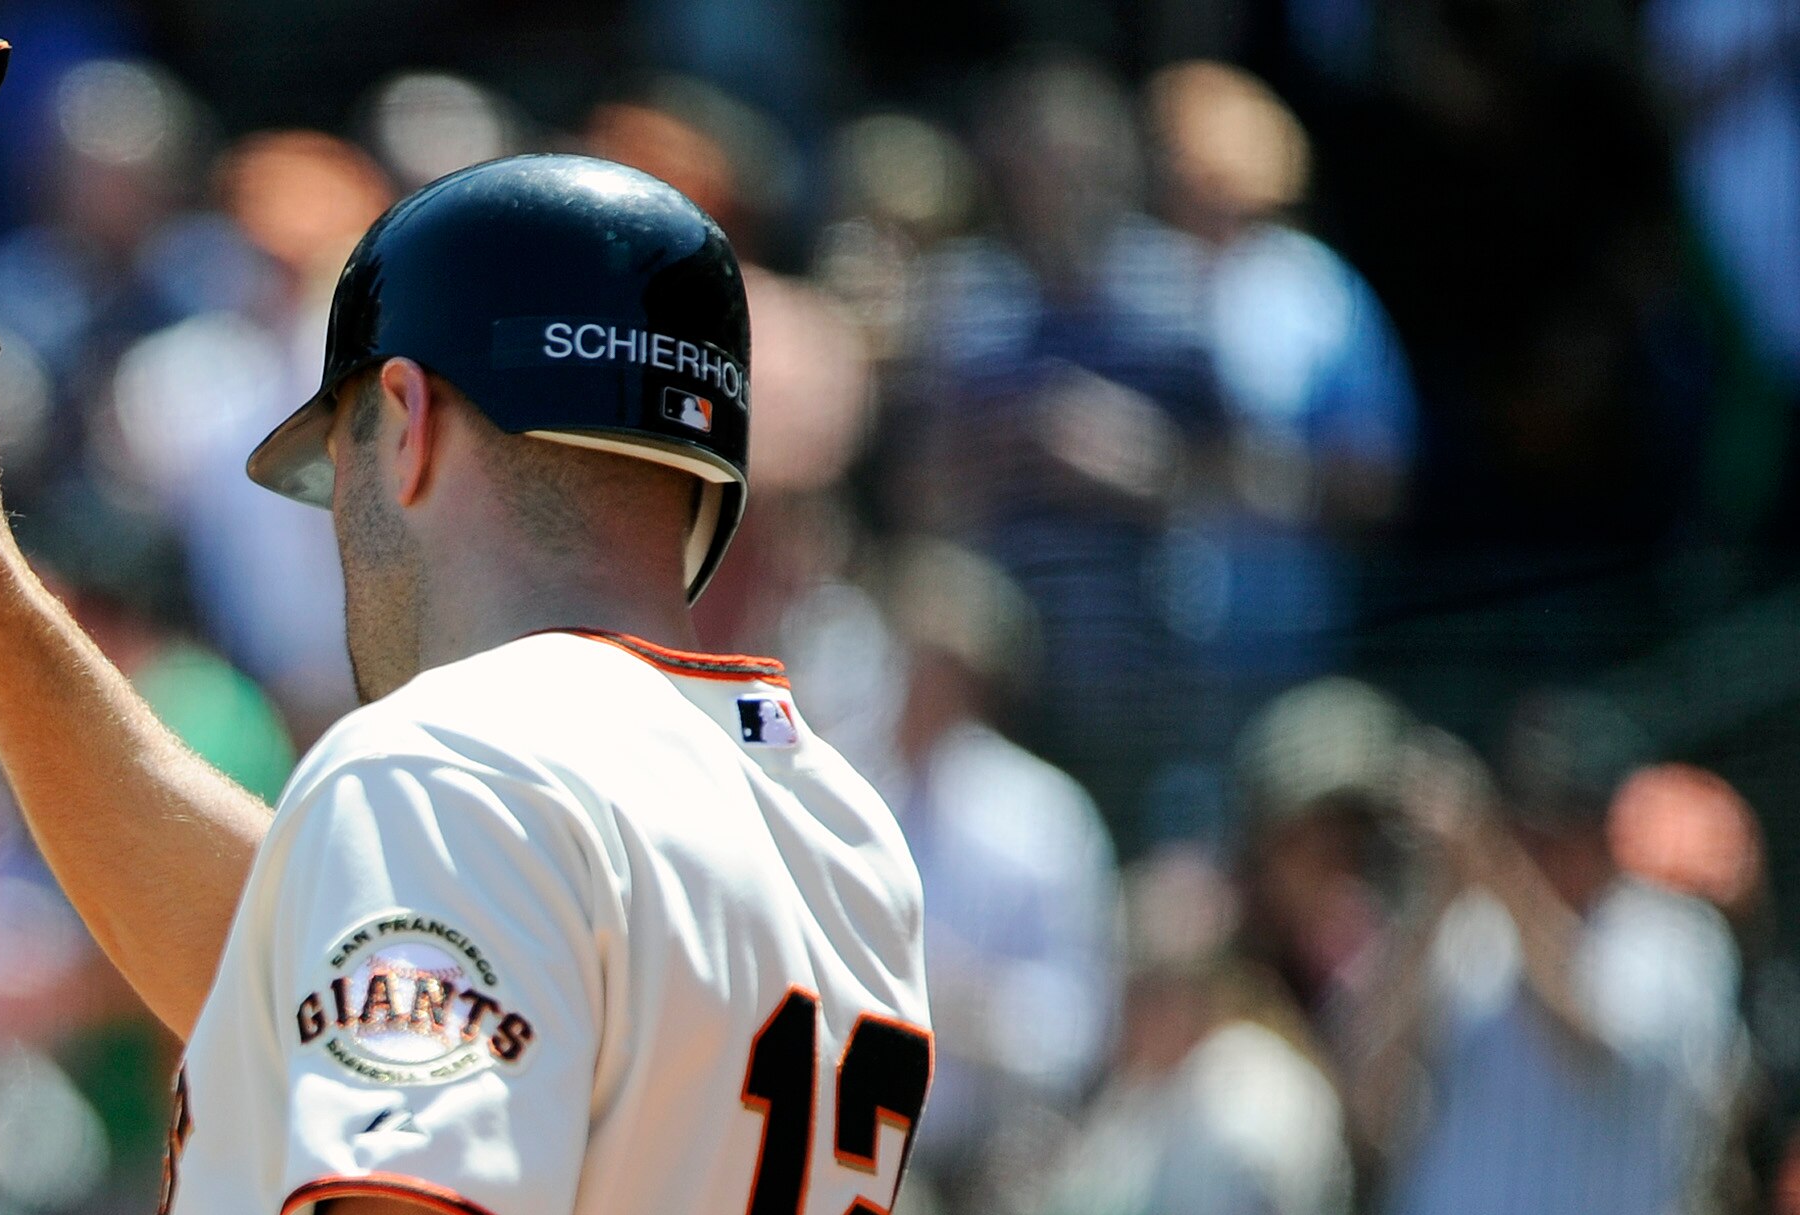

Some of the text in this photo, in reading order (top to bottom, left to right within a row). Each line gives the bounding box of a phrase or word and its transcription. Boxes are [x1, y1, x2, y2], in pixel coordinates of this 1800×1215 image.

[543, 322, 751, 413] SCHIERHOL
[329, 917, 498, 986] SAN FRANCISCO
[297, 973, 533, 1062] GIANTS
